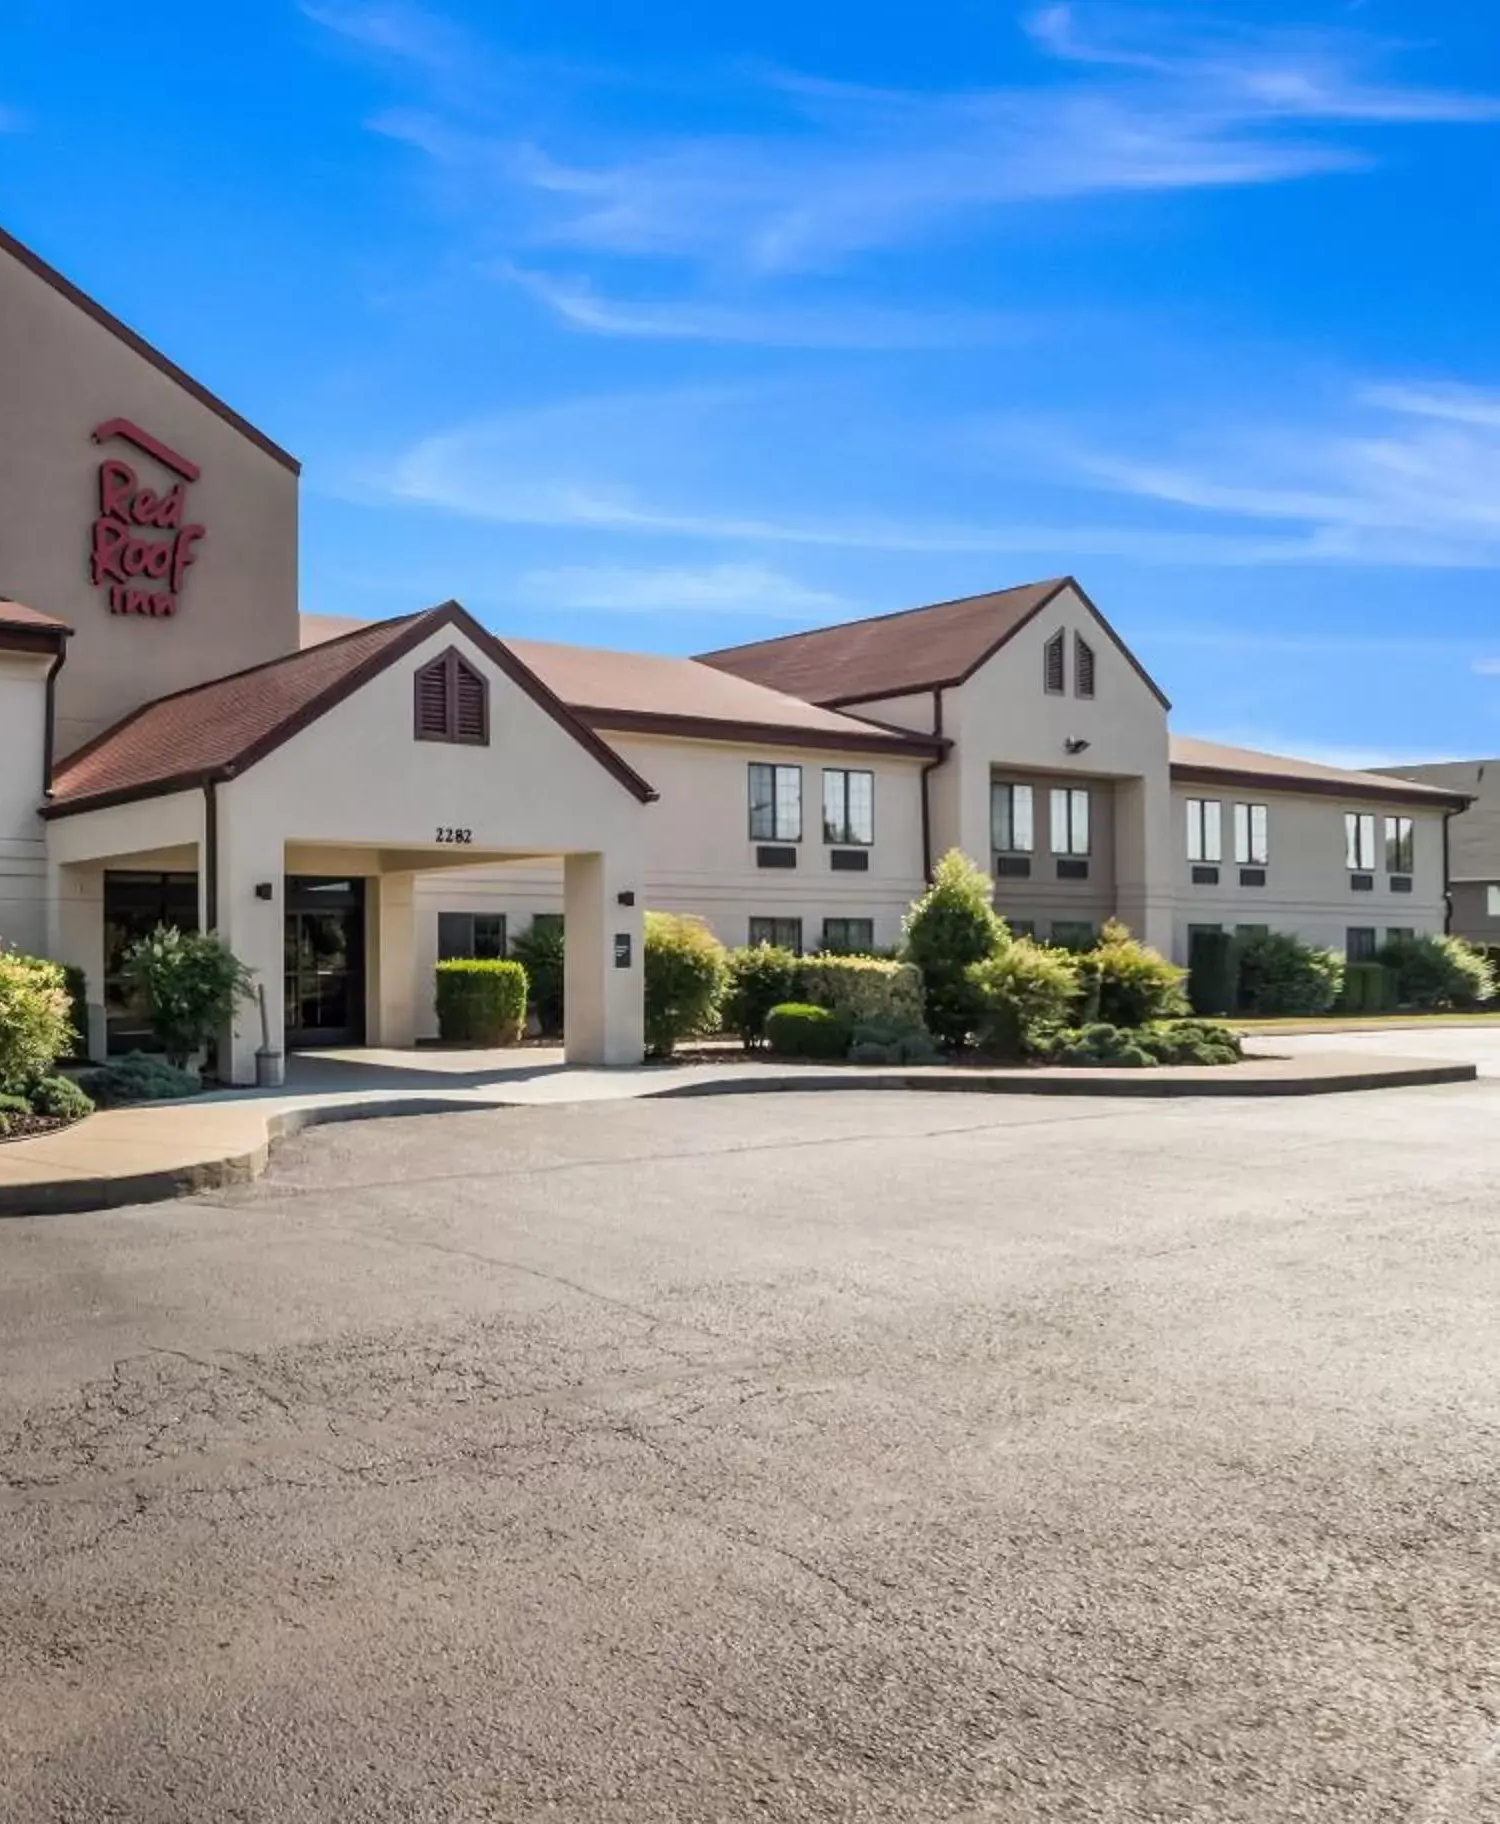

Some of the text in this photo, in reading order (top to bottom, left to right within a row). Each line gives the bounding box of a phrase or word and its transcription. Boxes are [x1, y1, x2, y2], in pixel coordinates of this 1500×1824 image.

[100, 459, 185, 528] Red
[91, 518, 206, 593] Roof
[436, 827, 472, 844] 2282
